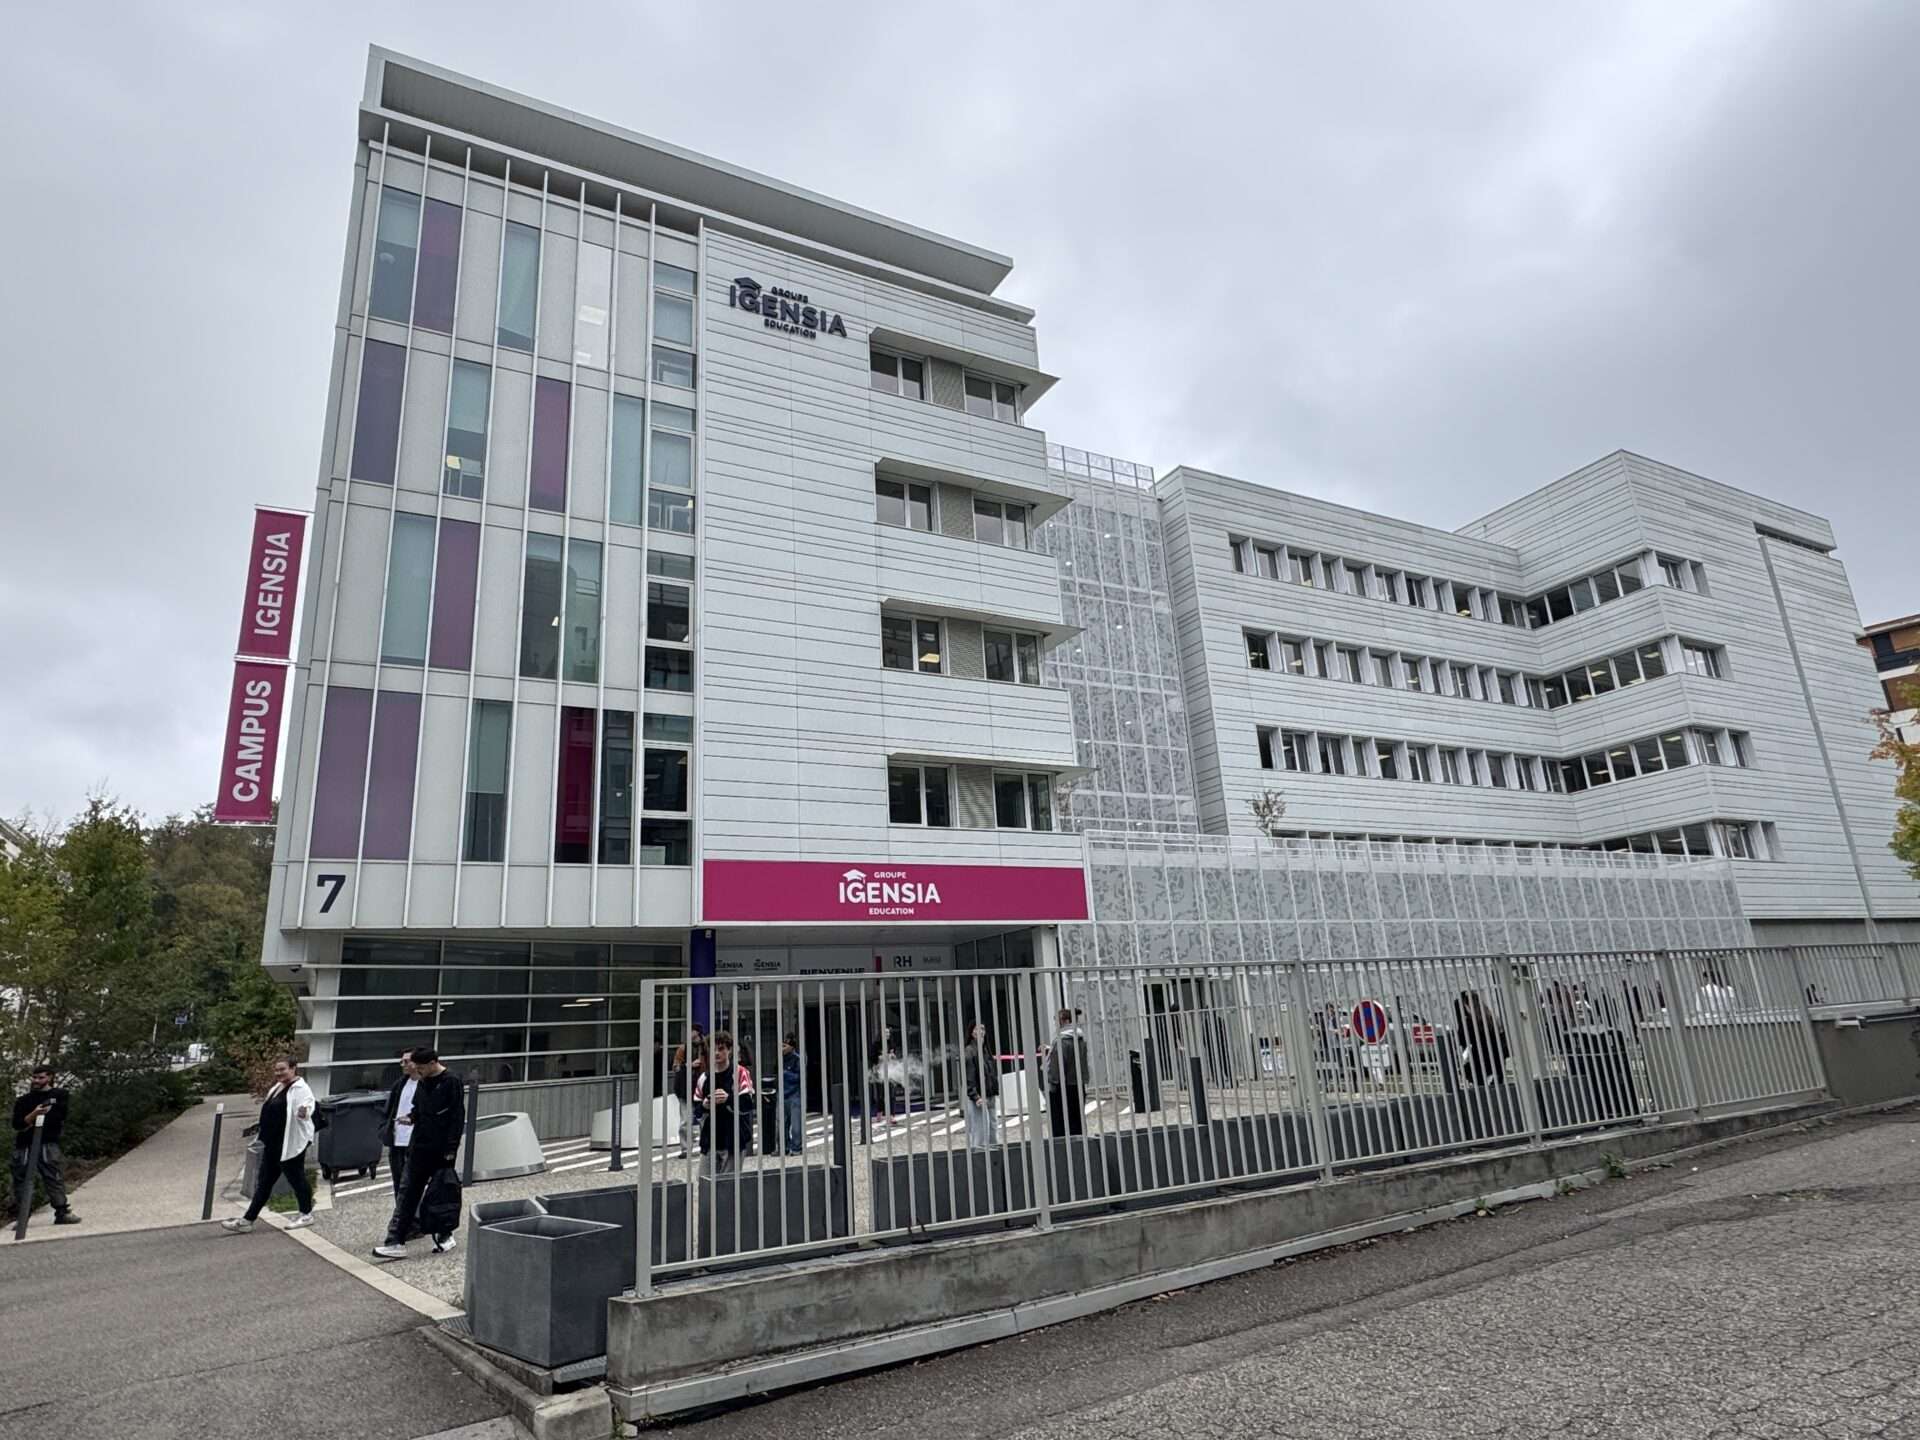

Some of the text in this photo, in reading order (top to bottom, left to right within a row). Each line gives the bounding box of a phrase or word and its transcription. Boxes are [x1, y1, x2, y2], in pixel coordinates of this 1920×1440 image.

[771, 286, 809, 303] GROUPE
[729, 285, 847, 338] IGENSIA
[764, 318, 817, 340] EDUCATION
[254, 532, 290, 636] IGENSIA
[232, 679, 272, 802] CAMPUS
[873, 871, 907, 879] GROUPE
[317, 874, 346, 913] 7
[839, 882, 941, 904] IGENSIA
[868, 907, 915, 915] EDUCATION
